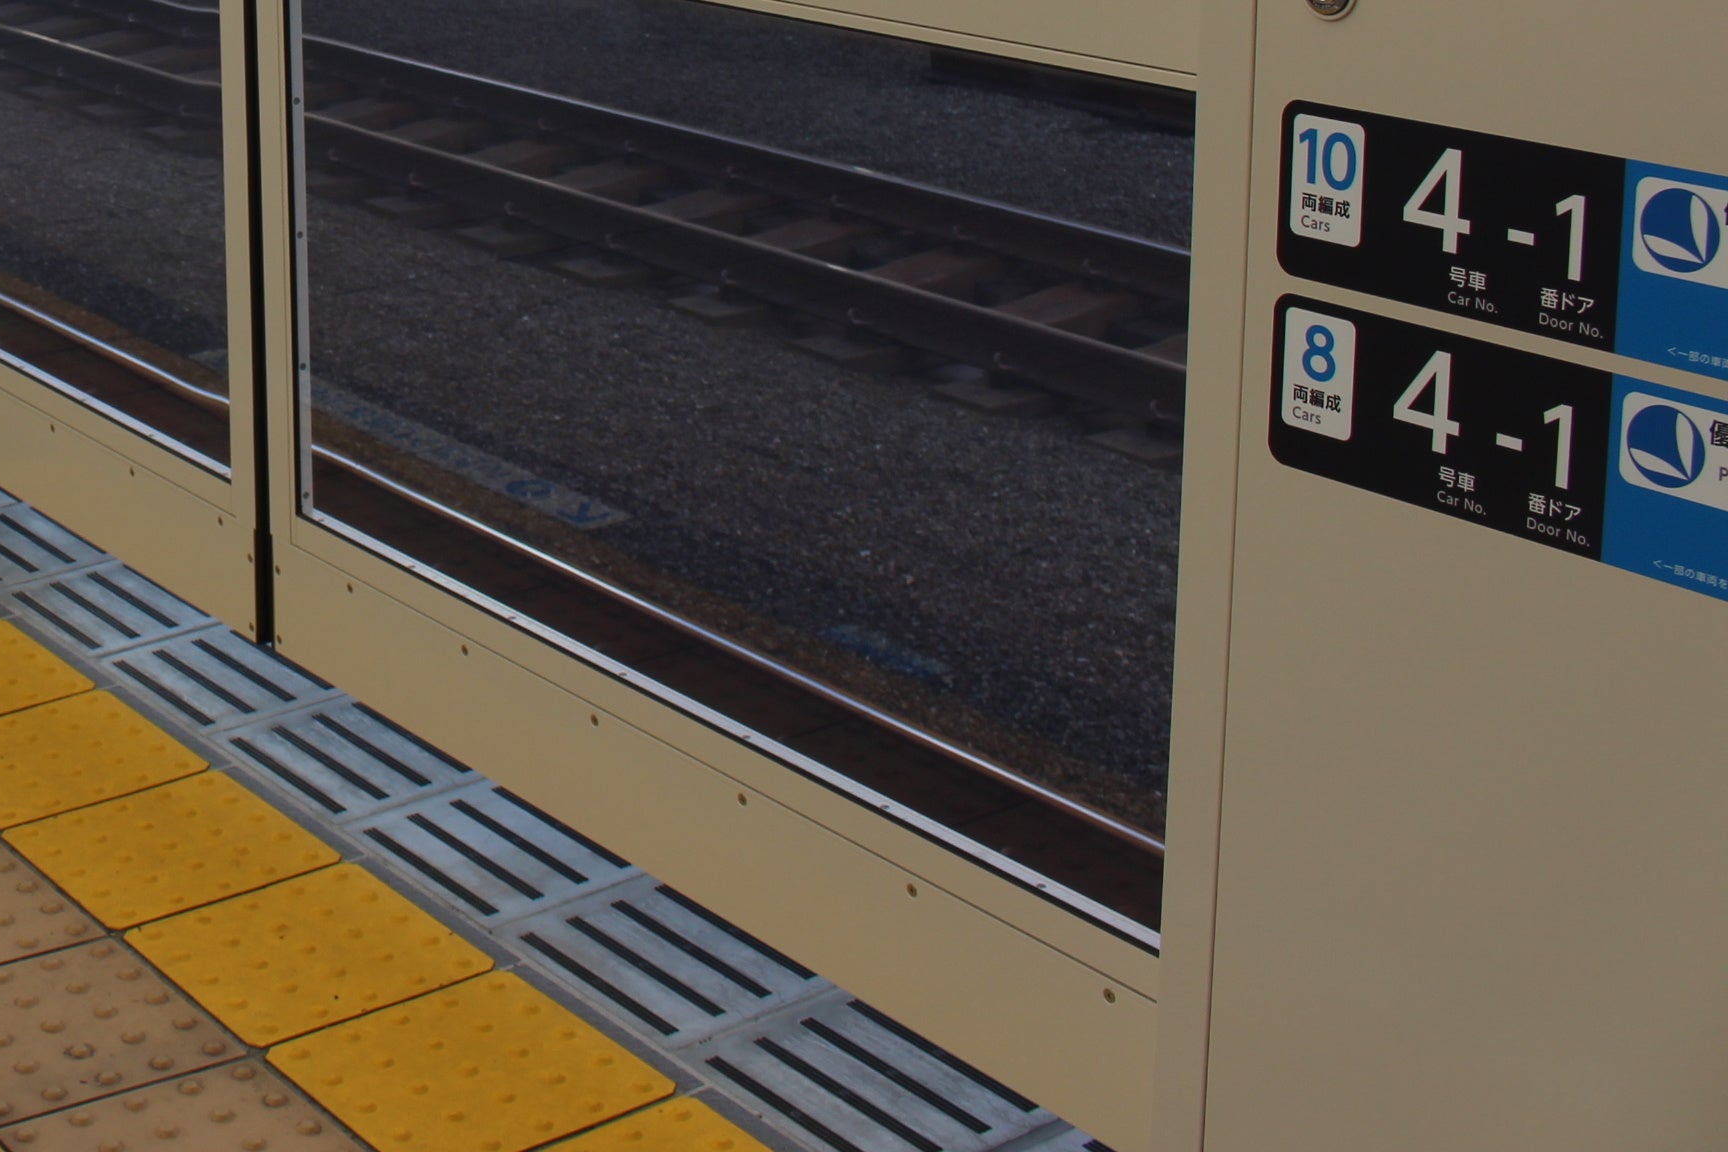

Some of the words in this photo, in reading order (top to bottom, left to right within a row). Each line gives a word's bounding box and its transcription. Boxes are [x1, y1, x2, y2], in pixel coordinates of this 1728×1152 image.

[1298, 127, 1358, 191] 10
[1300, 191, 1351, 220] 両編成
[1300, 214, 1331, 233] Cars
[1447, 290, 1471, 308] Car
[1474, 297, 1498, 314] No.
[1448, 266, 1487, 292] 号車
[1539, 287, 1594, 315] 番ドア
[1538, 311, 1574, 333] Door
[1578, 321, 1604, 340] No.
[1301, 323, 1336, 383] 8
[1292, 383, 1342, 413] 両編成
[1291, 406, 1321, 425] Cars
[1436, 490, 1460, 507] Car
[1463, 498, 1487, 516] No.
[1437, 465, 1476, 493] 号車
[1527, 493, 1582, 522] 番ドア
[1526, 517, 1562, 538] Door
[1565, 527, 1590, 547] No.
